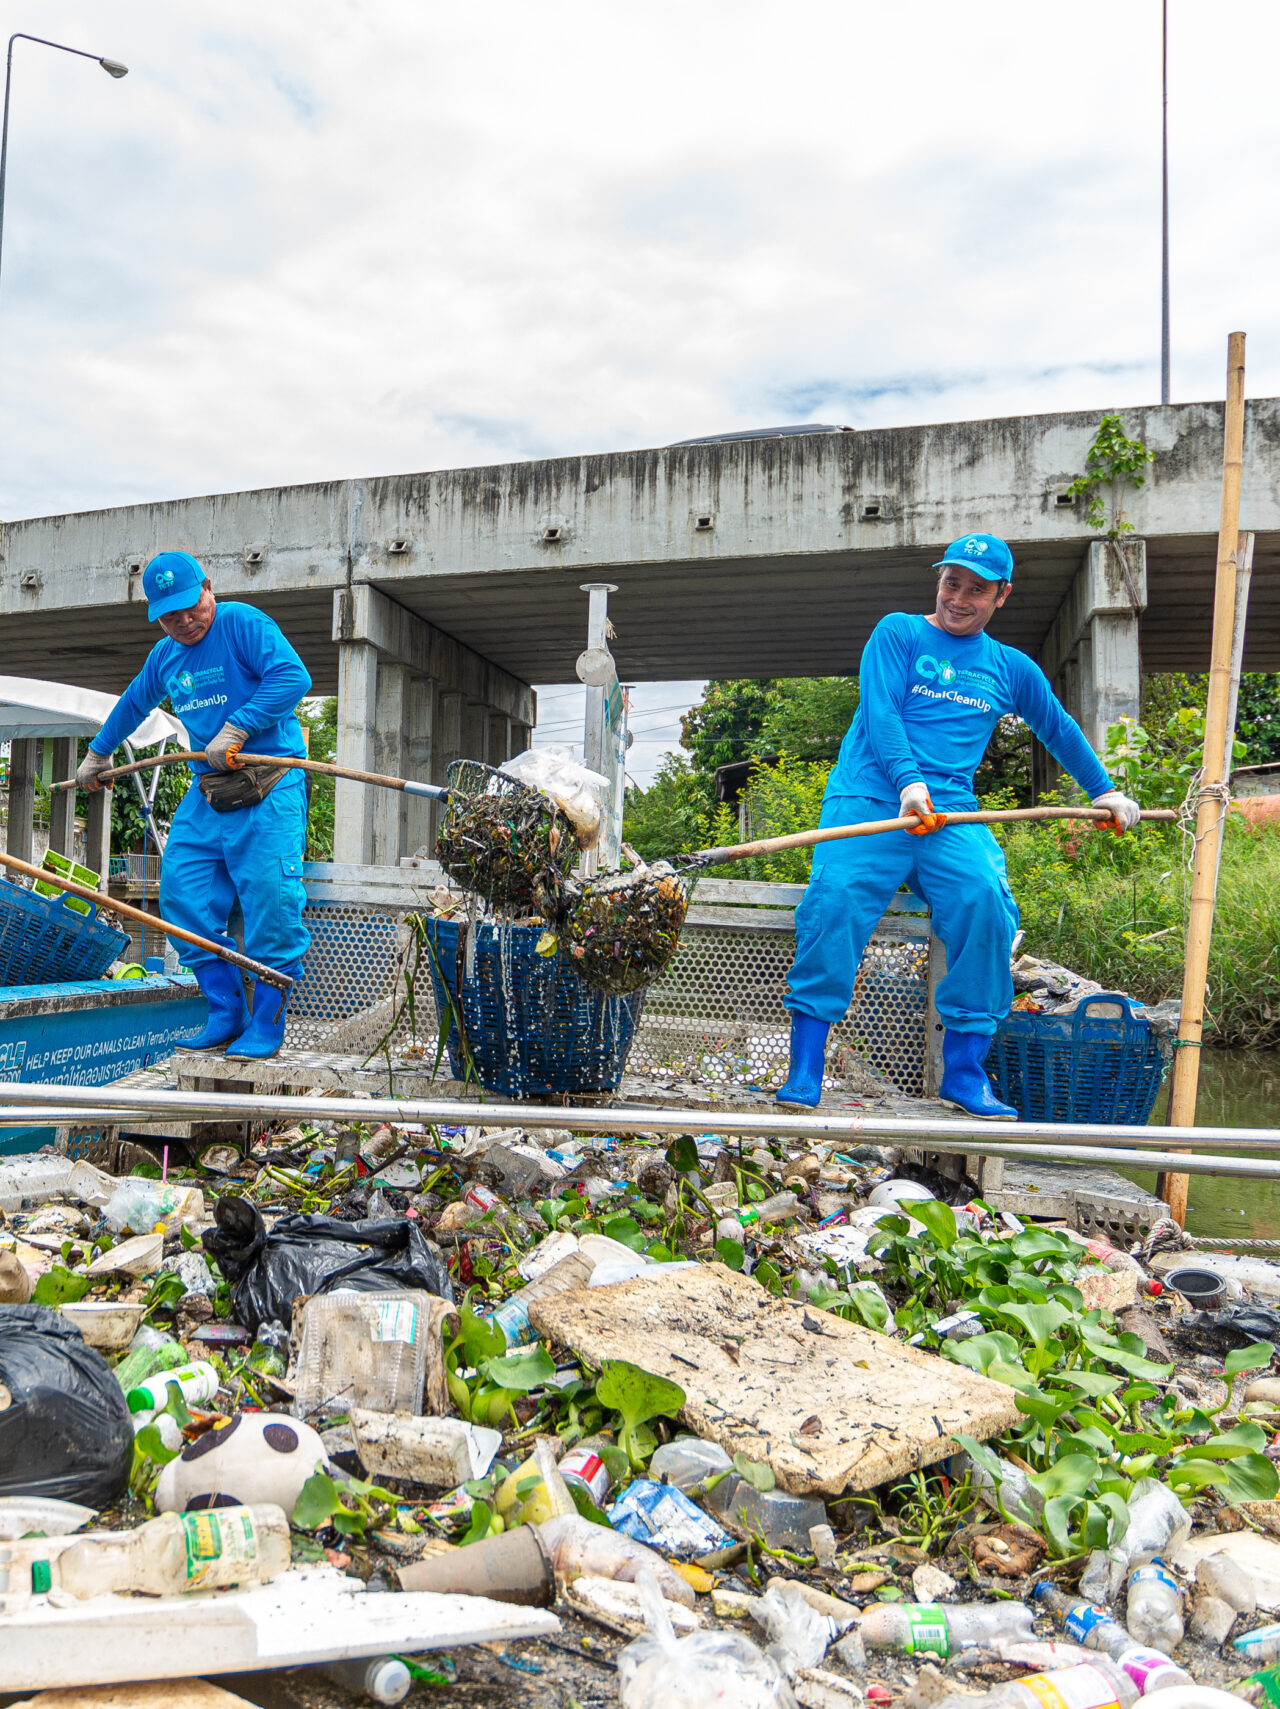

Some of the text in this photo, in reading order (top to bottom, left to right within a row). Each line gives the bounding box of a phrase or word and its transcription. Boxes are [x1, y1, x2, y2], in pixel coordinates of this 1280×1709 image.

[158, 581, 174, 590] TCTF
[911, 684, 991, 712] #CanalCleanUp
[25, 1052, 50, 1071] HELP
[50, 1048, 73, 1066] KEEP
[74, 1043, 92, 1061] OUR
[92, 1038, 122, 1057] CANALS
[123, 1034, 146, 1052] CLEAN
